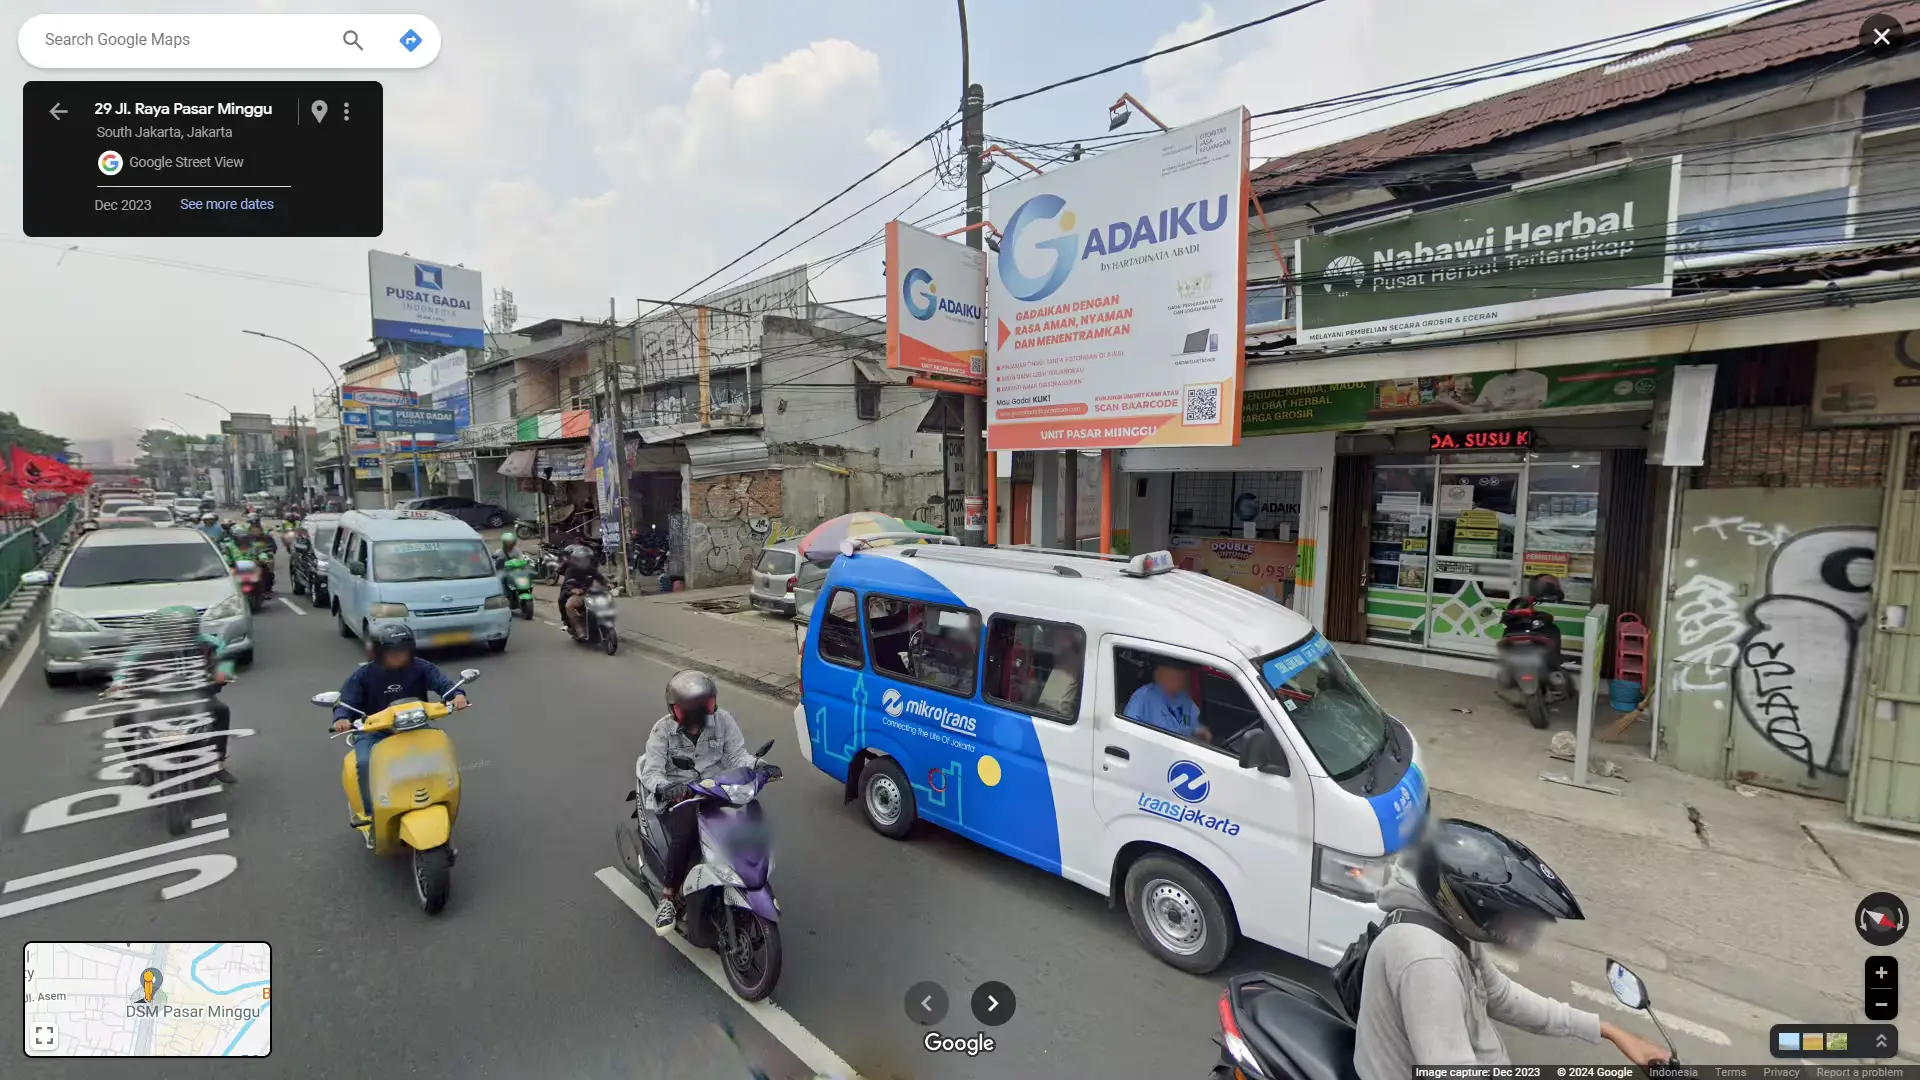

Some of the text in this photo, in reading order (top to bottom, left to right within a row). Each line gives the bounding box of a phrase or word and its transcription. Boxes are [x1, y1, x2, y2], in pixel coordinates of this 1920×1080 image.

[1373, 201, 1635, 273] Nabawi Herbal
[1101, 243, 1200, 273] by HARTADINATA ABADI
[1373, 271, 1424, 292] Pusat
[386, 286, 471, 310] PUSAT GADAI
[1015, 294, 1120, 322] GADAIKAN DENGAN
[1015, 307, 1133, 337] RASA AMAN, NYAMAN
[1310, 311, 1498, 341] MELAYANI PEMBELIAN SECARA GROSIR & ECERAN
[1014, 323, 1131, 350] DAN MENENTRAMKAN
[1286, 384, 1327, 396] KURMA,
[1094, 402, 1119, 413] SCAN
[1262, 401, 1287, 411] OBAT
[1291, 395, 1333, 408] HERBAL
[1275, 409, 1313, 421] GROSIR
[1040, 430, 1065, 440] UNIT
[1066, 428, 1103, 439] PASAR
[1464, 431, 1511, 448] SUSU
[1211, 541, 1256, 554] DOUBLE
[905, 699, 977, 737] mikrotrans
[882, 716, 917, 736] Connecting
[917, 728, 929, 738] The
[951, 739, 975, 753] Jakarta
[1137, 791, 1241, 836] transjakarta
